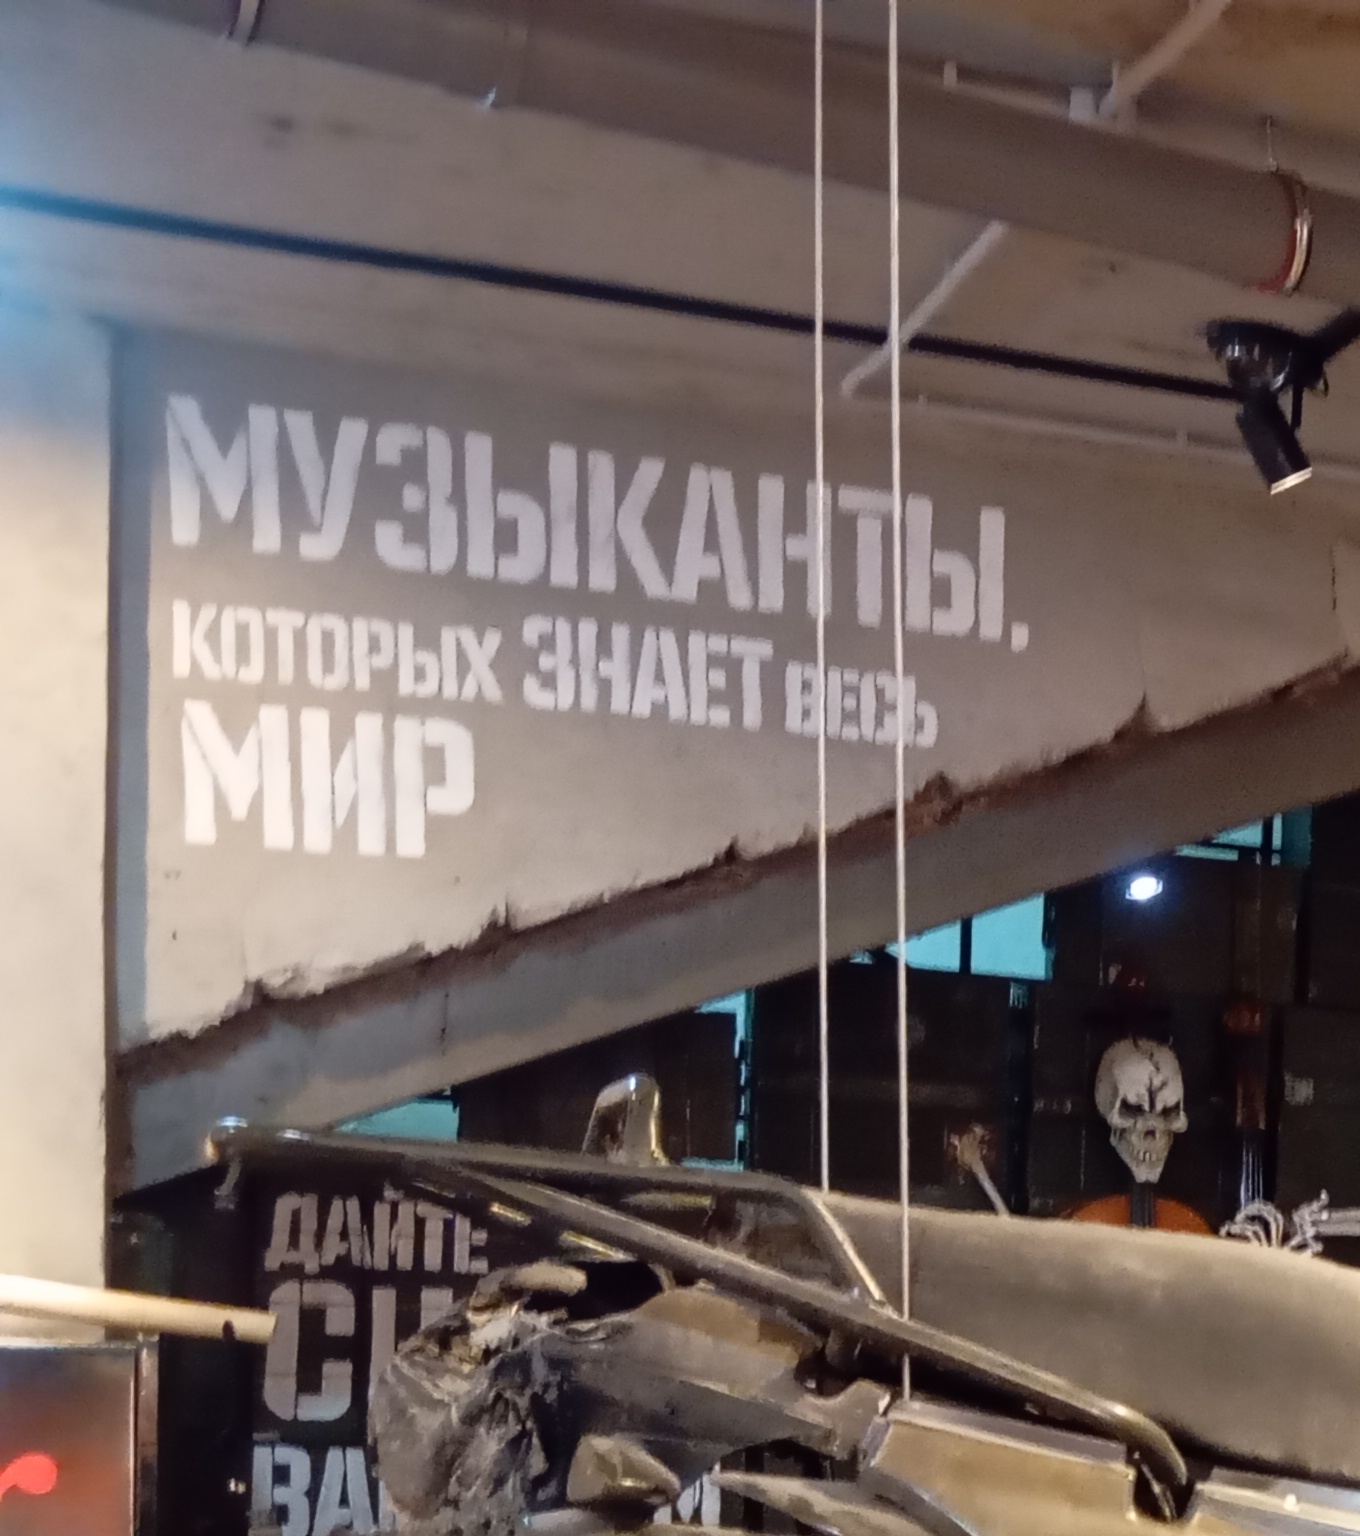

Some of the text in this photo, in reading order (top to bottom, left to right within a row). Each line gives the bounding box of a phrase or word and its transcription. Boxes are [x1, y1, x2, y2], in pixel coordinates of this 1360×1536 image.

[171, 600, 938, 748] КОТОРЫХ ЗНАЕТ ВЕСЬ
[180, 699, 476, 859] МИР
[264, 1183, 489, 1275] ДАЙТЕ
